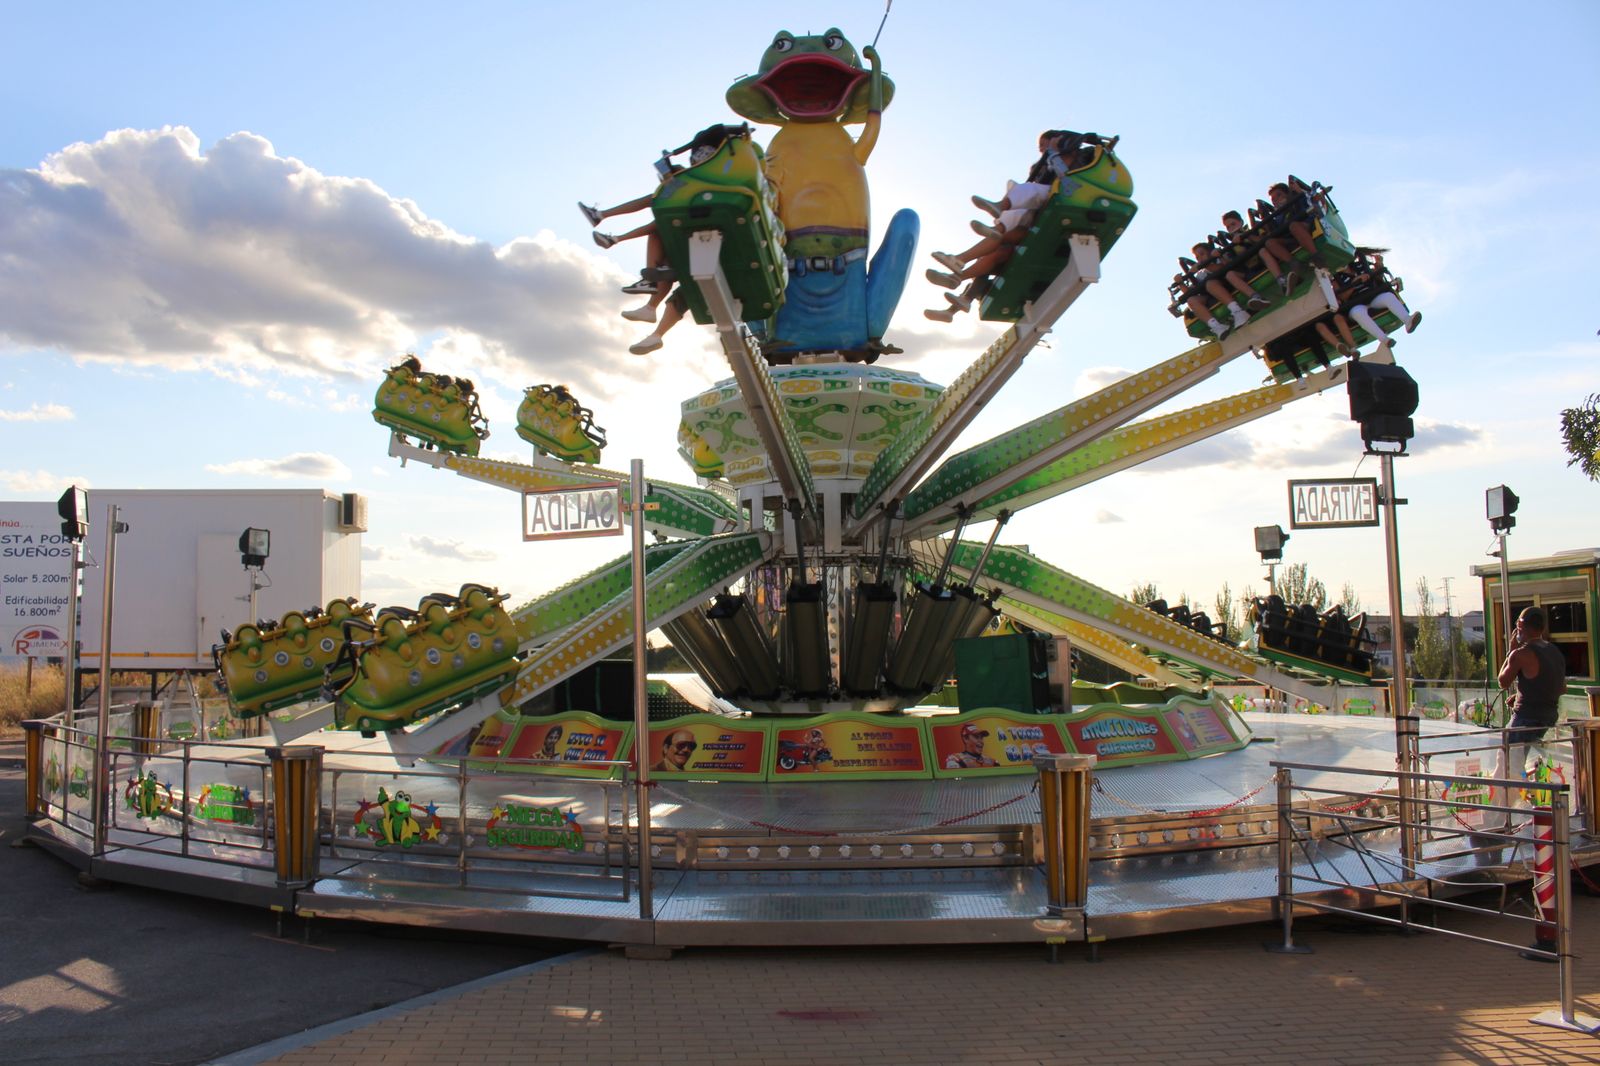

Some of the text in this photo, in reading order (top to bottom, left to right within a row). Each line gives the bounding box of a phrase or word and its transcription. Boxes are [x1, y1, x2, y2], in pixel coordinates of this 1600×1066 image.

[3, 544, 71, 557] SUEÑOS
[3, 573, 71, 583] Solar 5.200m
[5, 595, 69, 605] Edificabilidad
[1096, 738, 1156, 756] GUERRERO
[506, 804, 564, 827] MEGA
